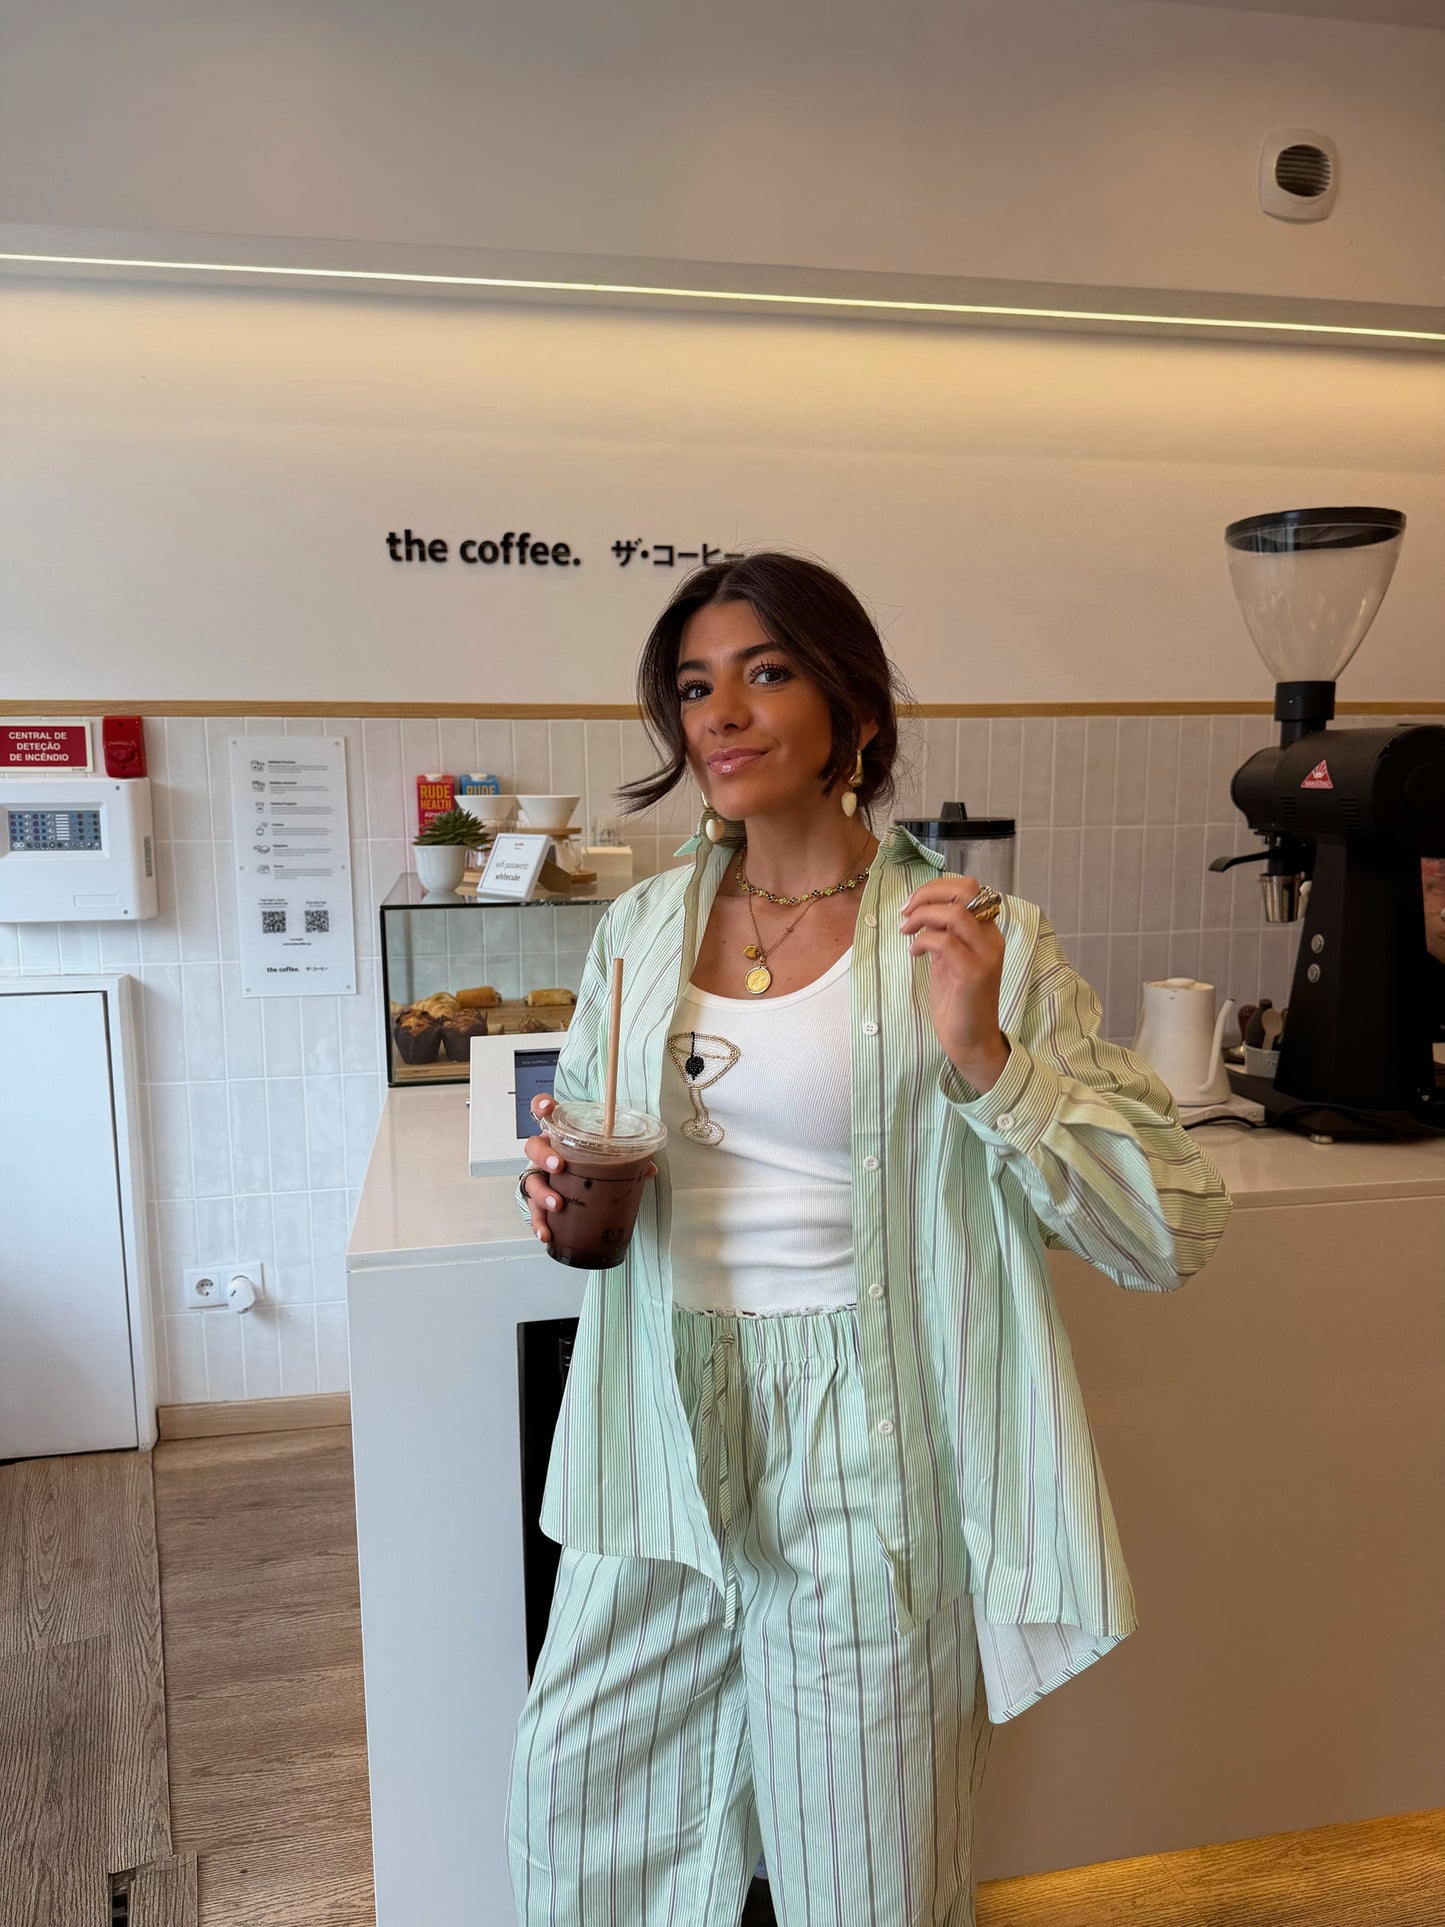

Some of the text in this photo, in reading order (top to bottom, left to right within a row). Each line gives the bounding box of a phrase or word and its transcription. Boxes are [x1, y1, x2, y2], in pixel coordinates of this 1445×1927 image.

[386, 529, 582, 567] the coffee.
[9, 732, 67, 740] CENTRAL DE
[16, 741, 61, 752] DETEÇÃO
[9, 751, 69, 762] DE INCÊNDIO
[420, 785, 451, 799] RUDE
[466, 785, 496, 796] RUDE
[420, 799, 452, 810] HEALTH
